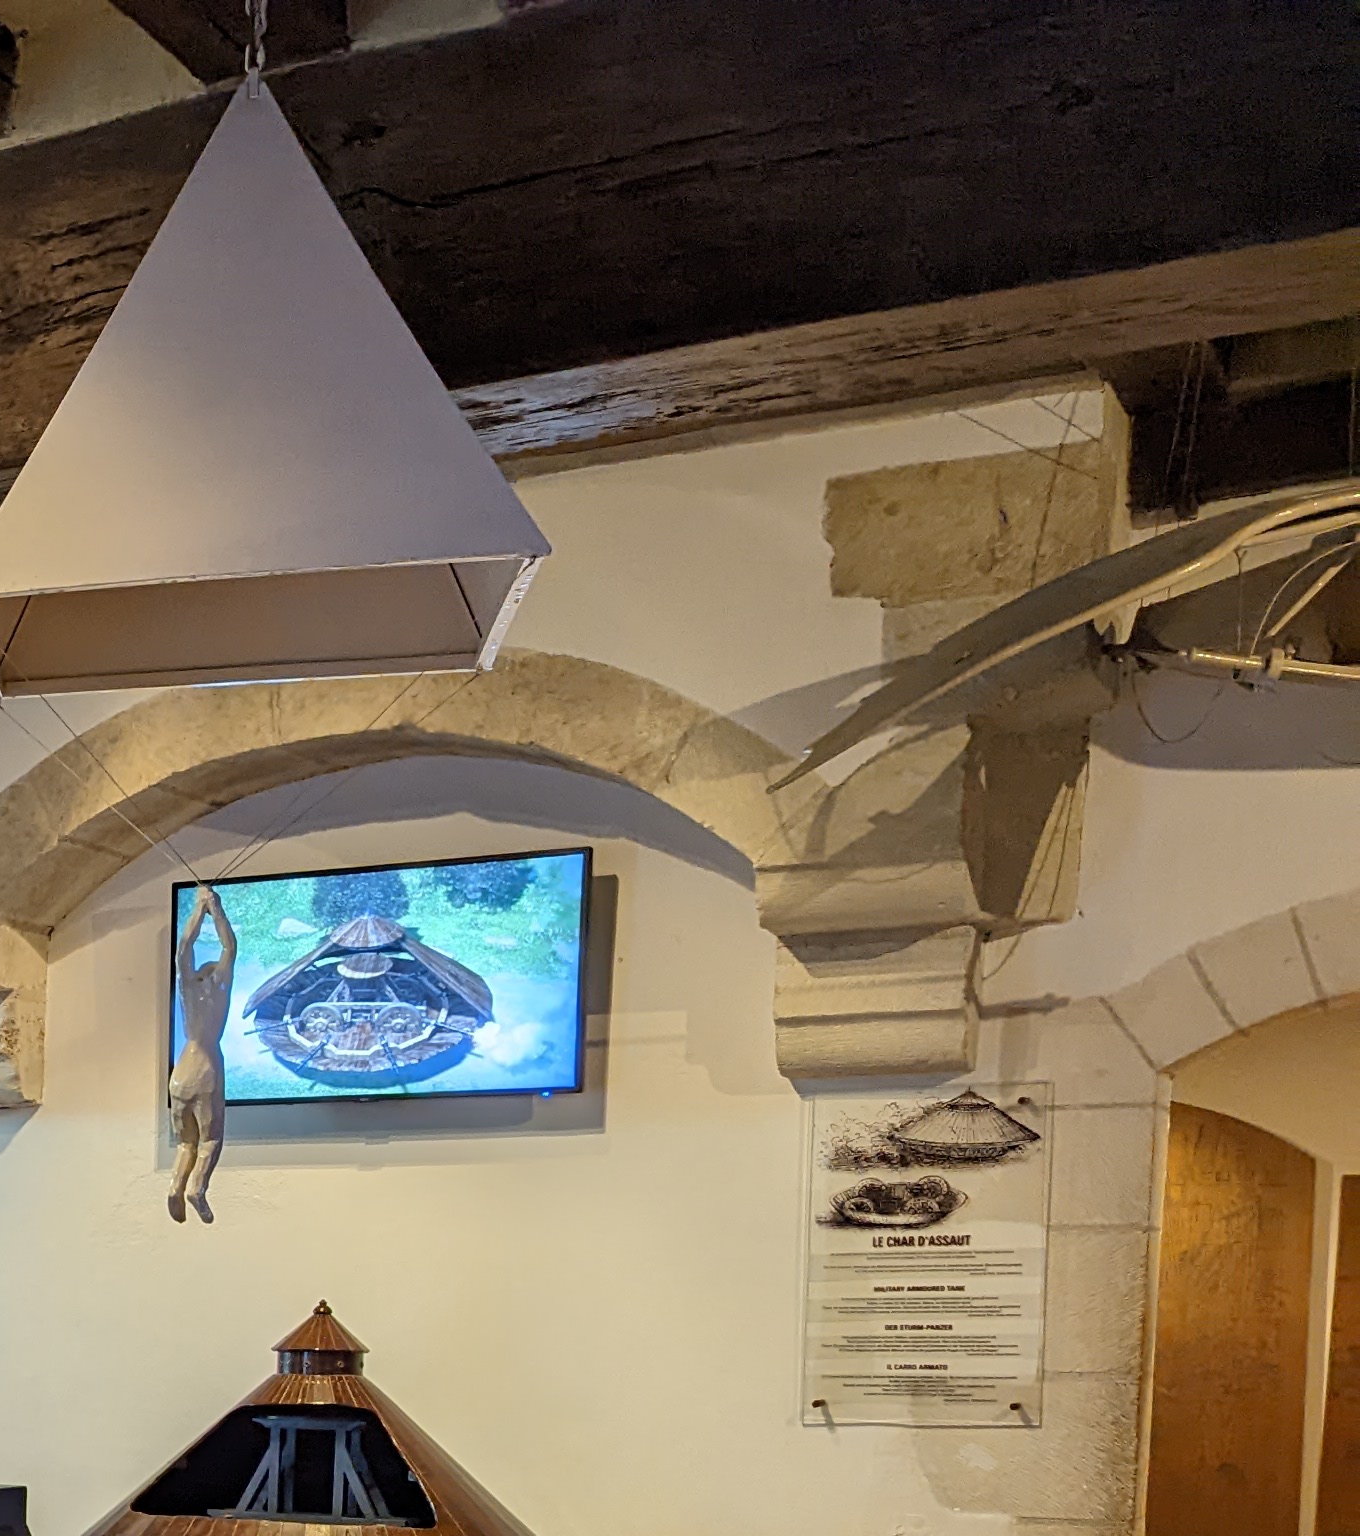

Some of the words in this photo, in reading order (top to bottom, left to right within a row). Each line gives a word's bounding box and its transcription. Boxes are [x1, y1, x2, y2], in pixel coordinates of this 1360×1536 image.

[873, 1237, 883, 1248] LE
[887, 1236, 915, 1247] CHAR
[918, 1235, 971, 1246] D'ASSAUT
